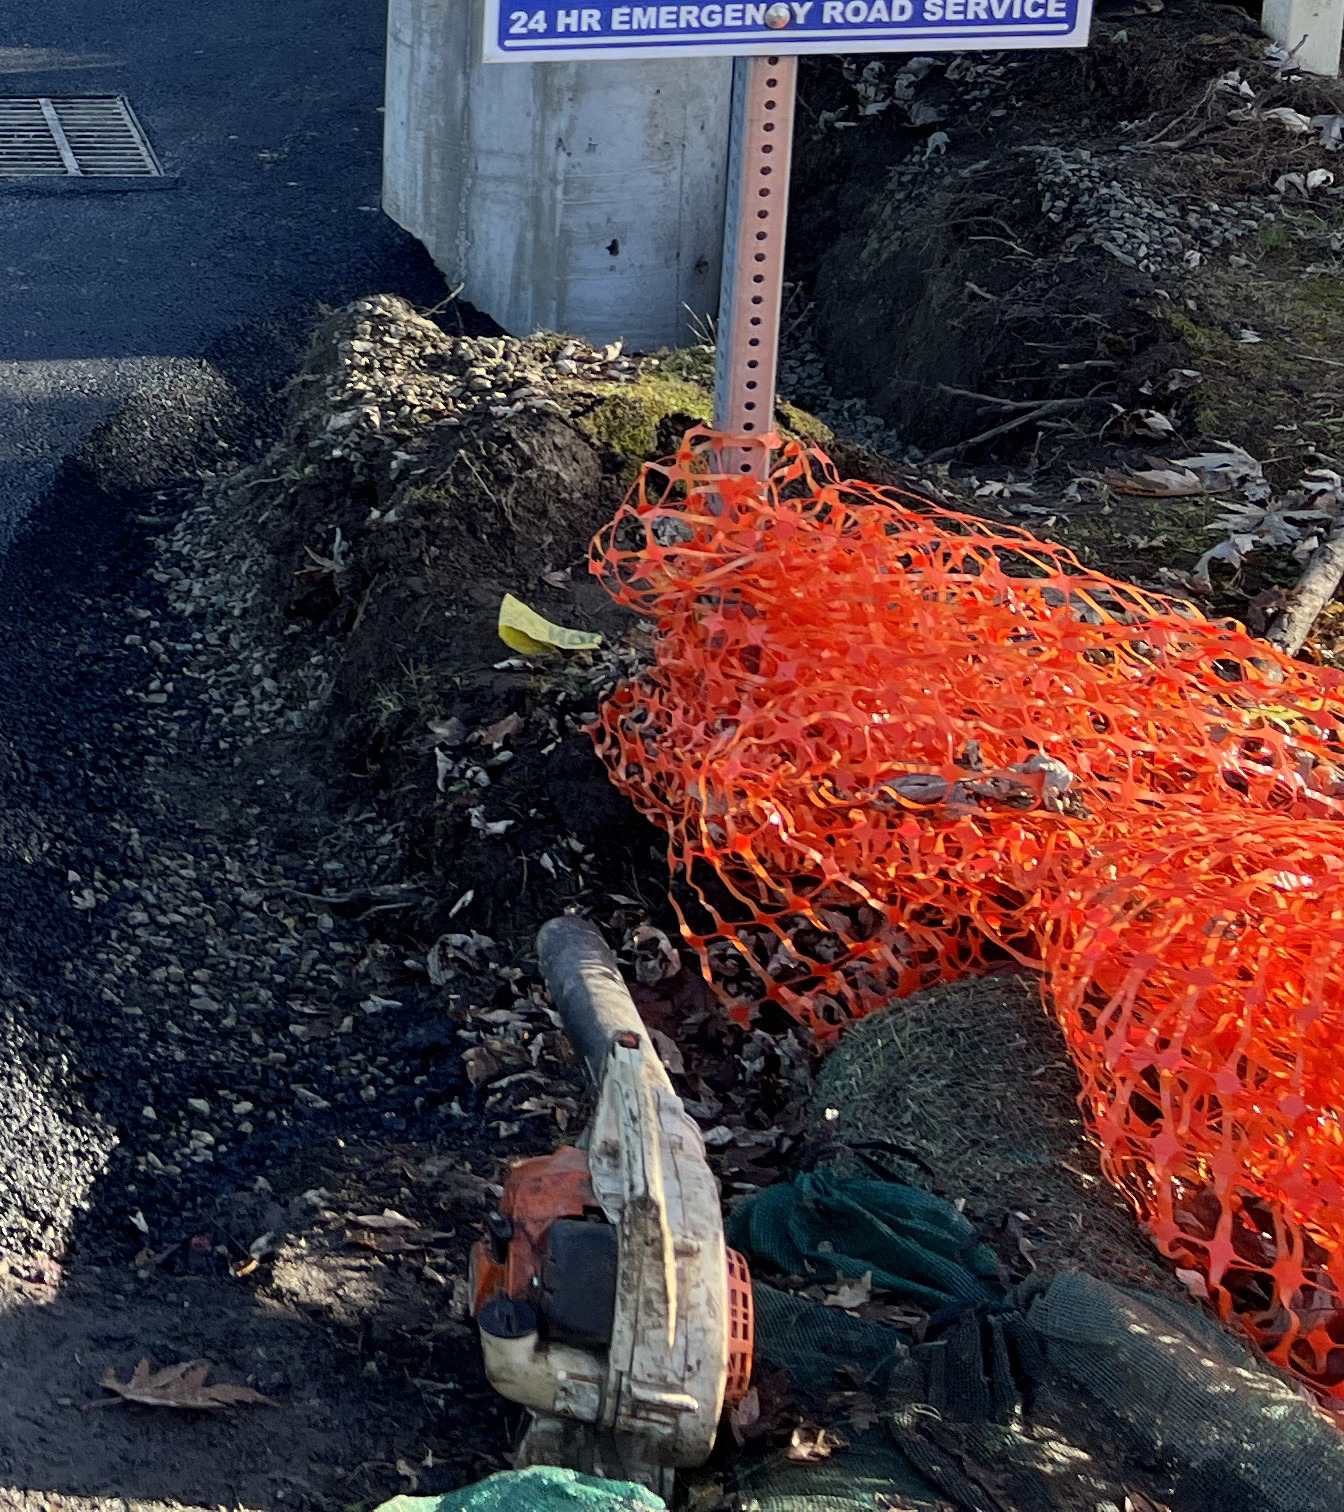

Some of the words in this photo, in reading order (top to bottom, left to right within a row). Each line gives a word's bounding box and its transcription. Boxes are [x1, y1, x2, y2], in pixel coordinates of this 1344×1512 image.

[509, 10, 547, 33] 24
[557, 9, 601, 32] HR
[611, 2, 813, 30] EMERGENY
[823, 0, 913, 23] ROAD
